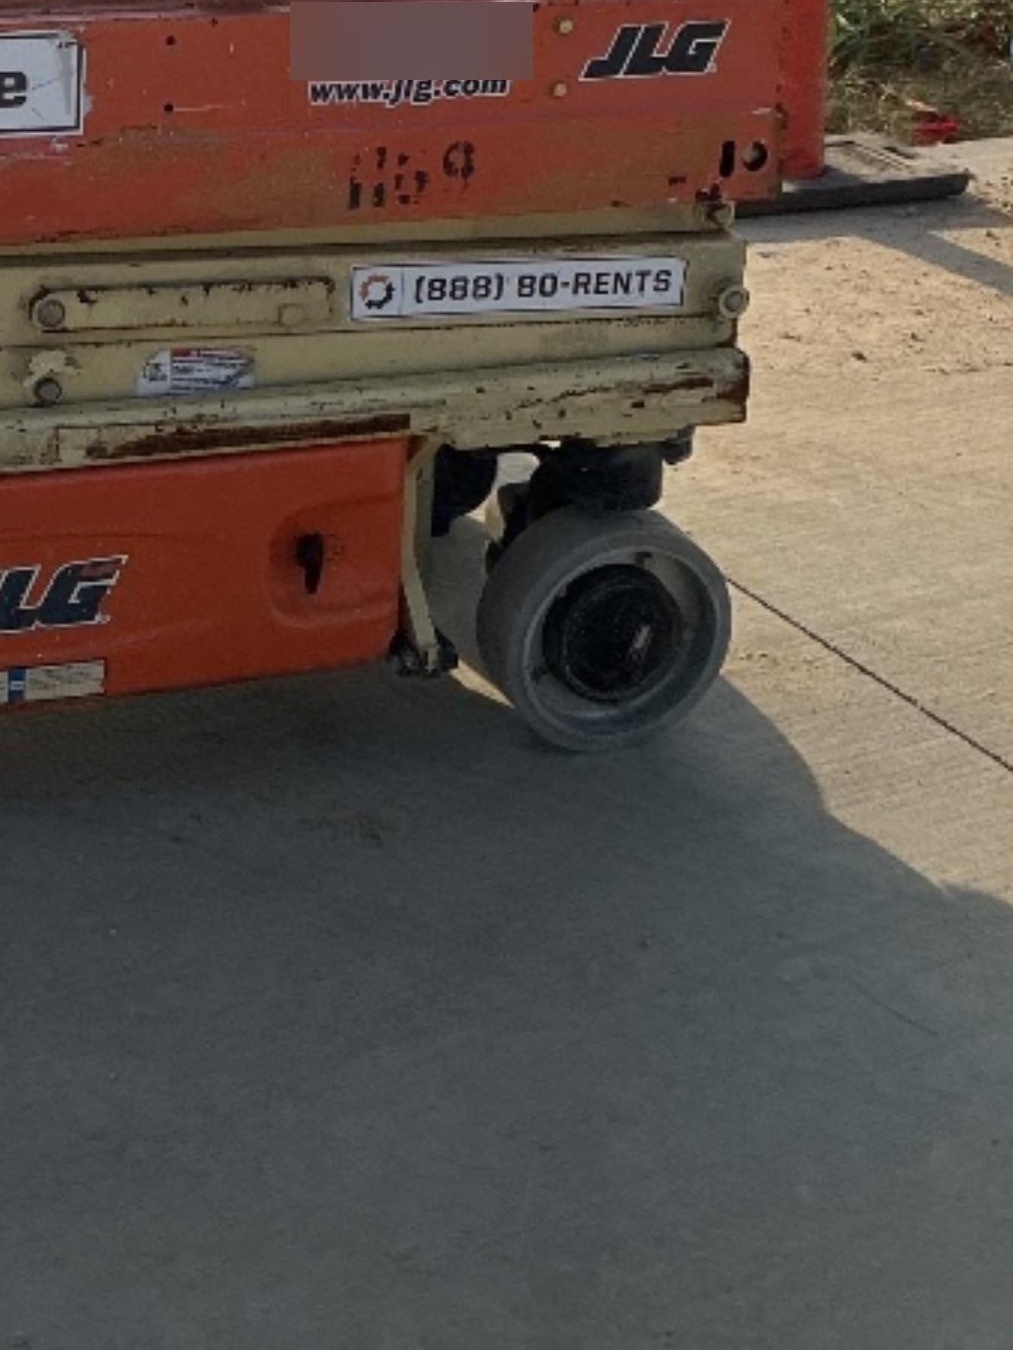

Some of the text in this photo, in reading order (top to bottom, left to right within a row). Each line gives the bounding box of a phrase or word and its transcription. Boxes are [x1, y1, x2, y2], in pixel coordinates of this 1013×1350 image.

[579, 19, 731, 81] JLG
[309, 79, 509, 106] www.jlg.com
[414, 269, 673, 304] (888) 80-RENTS
